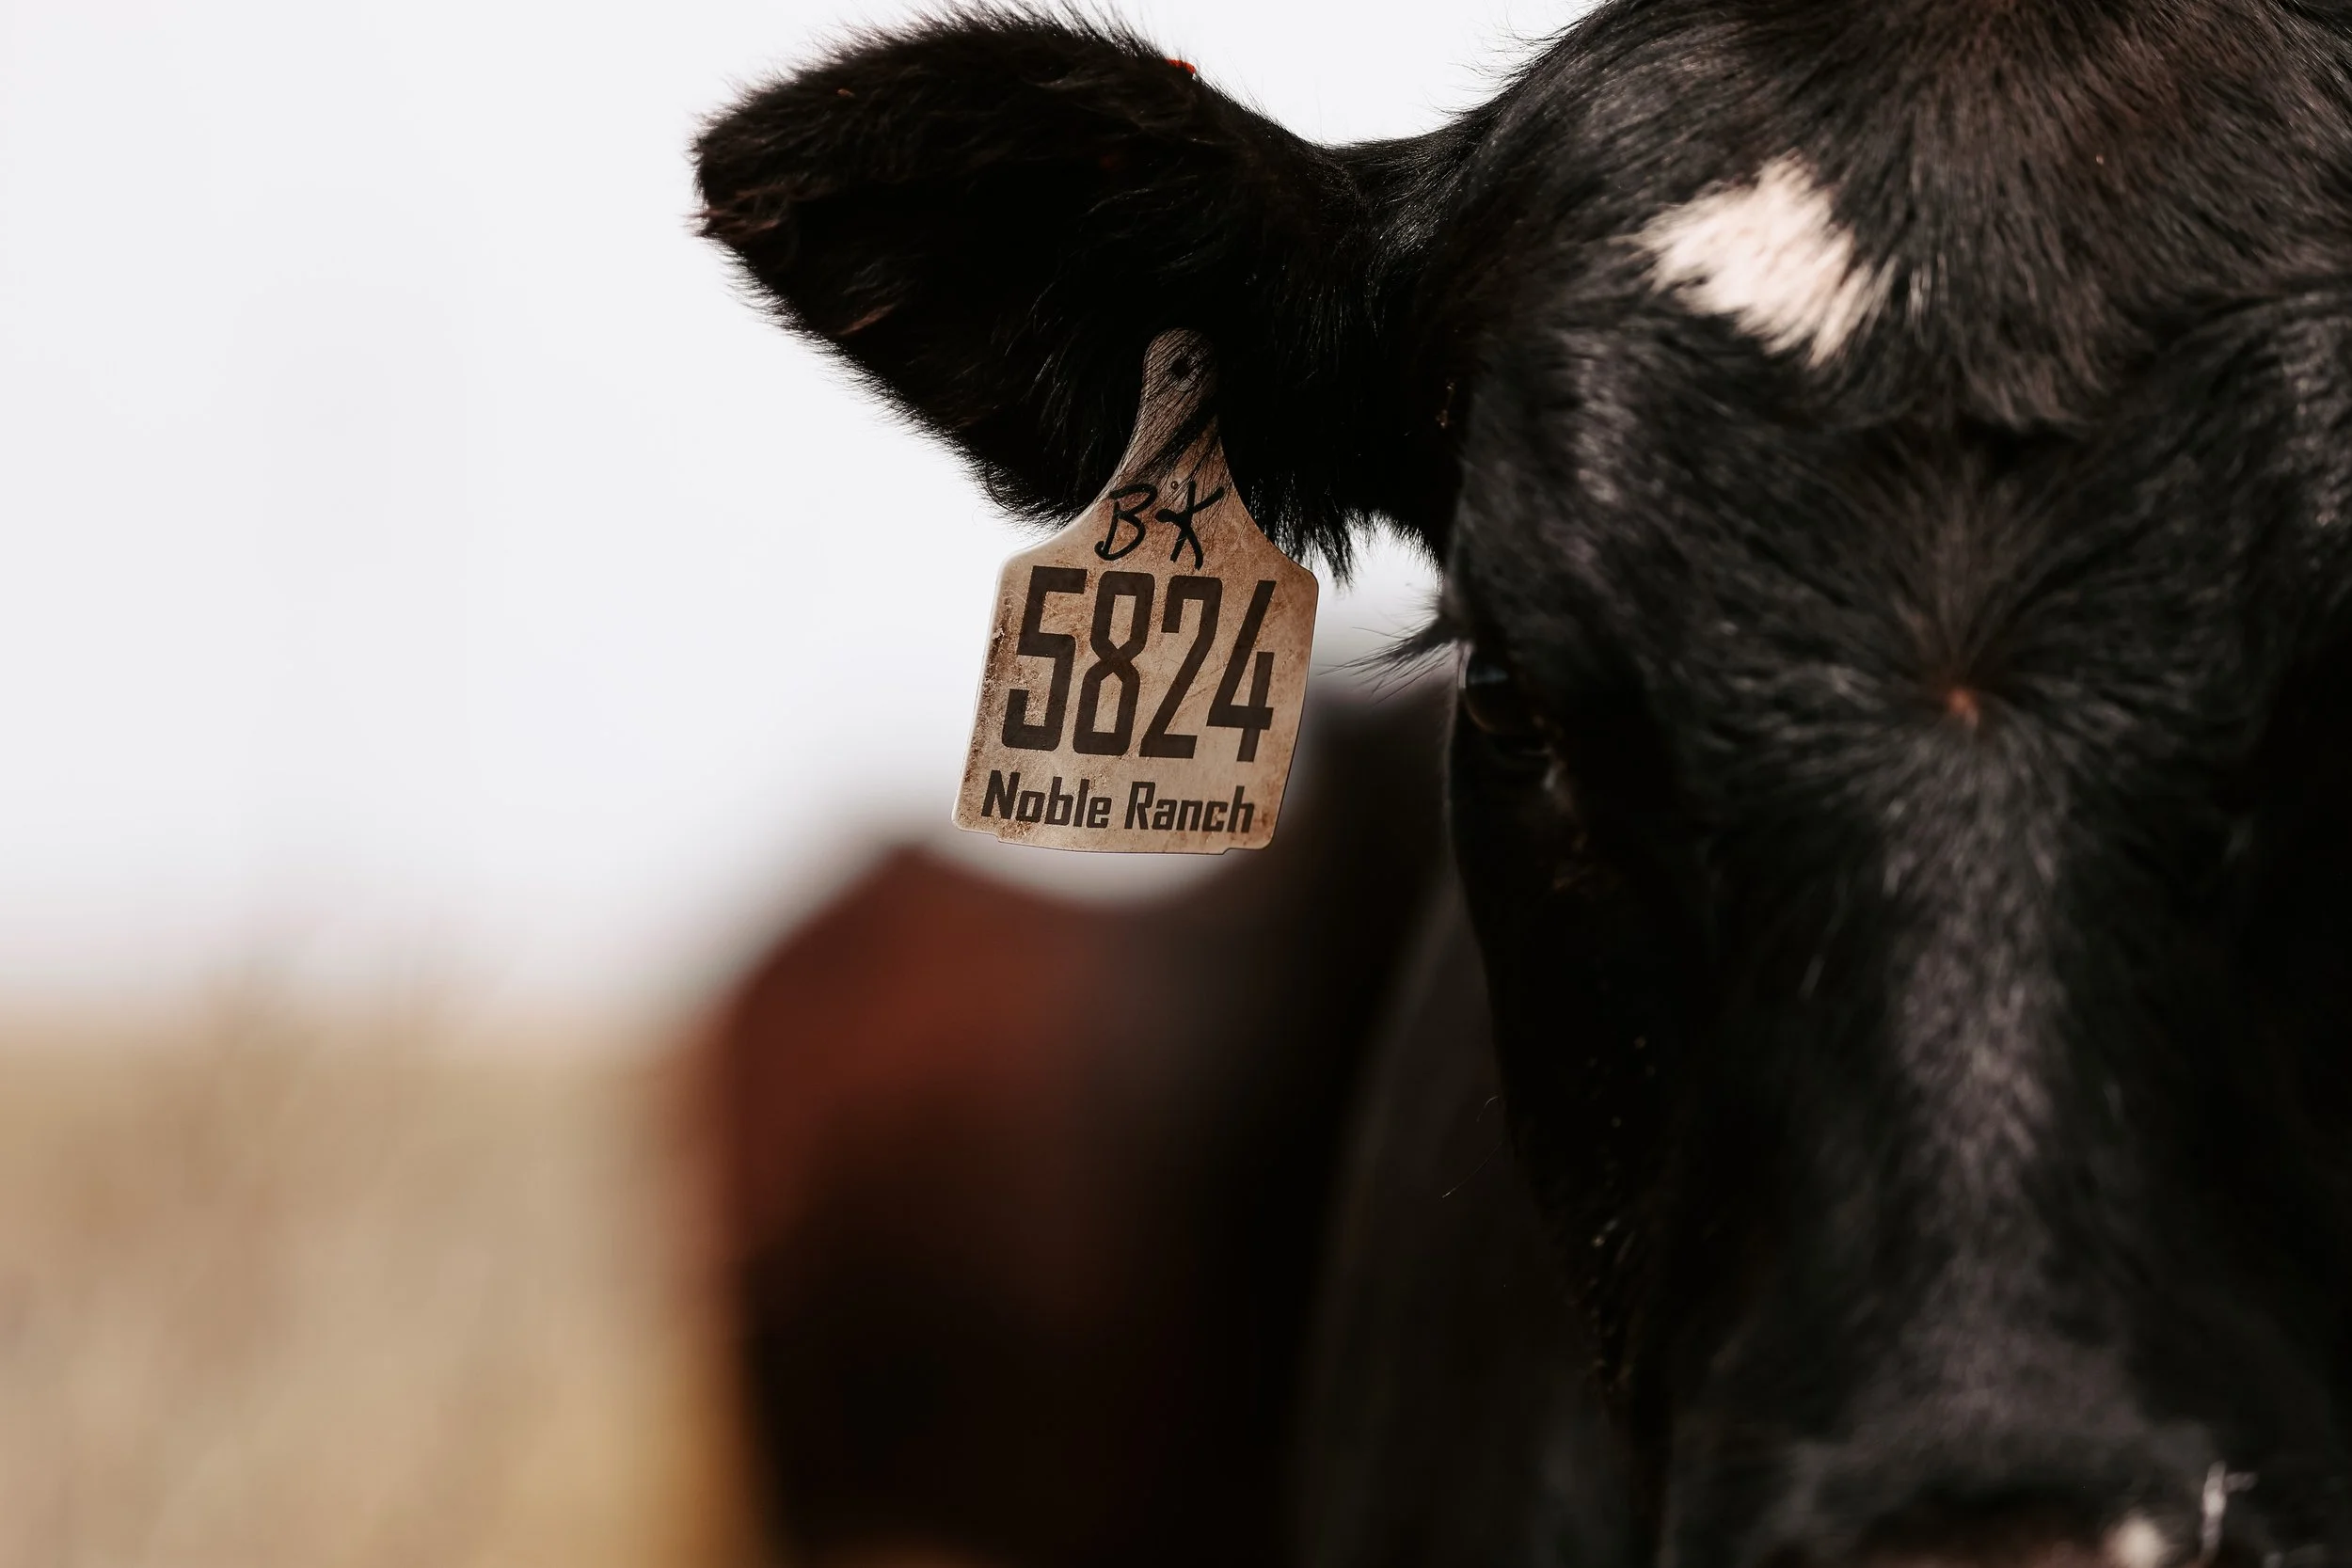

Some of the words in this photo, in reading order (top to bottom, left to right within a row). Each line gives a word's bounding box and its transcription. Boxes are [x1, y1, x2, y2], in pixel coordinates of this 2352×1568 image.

[1001, 565, 1277, 763] 5824
[981, 769, 1112, 830] Noble
[1123, 781, 1256, 833] Ranch
